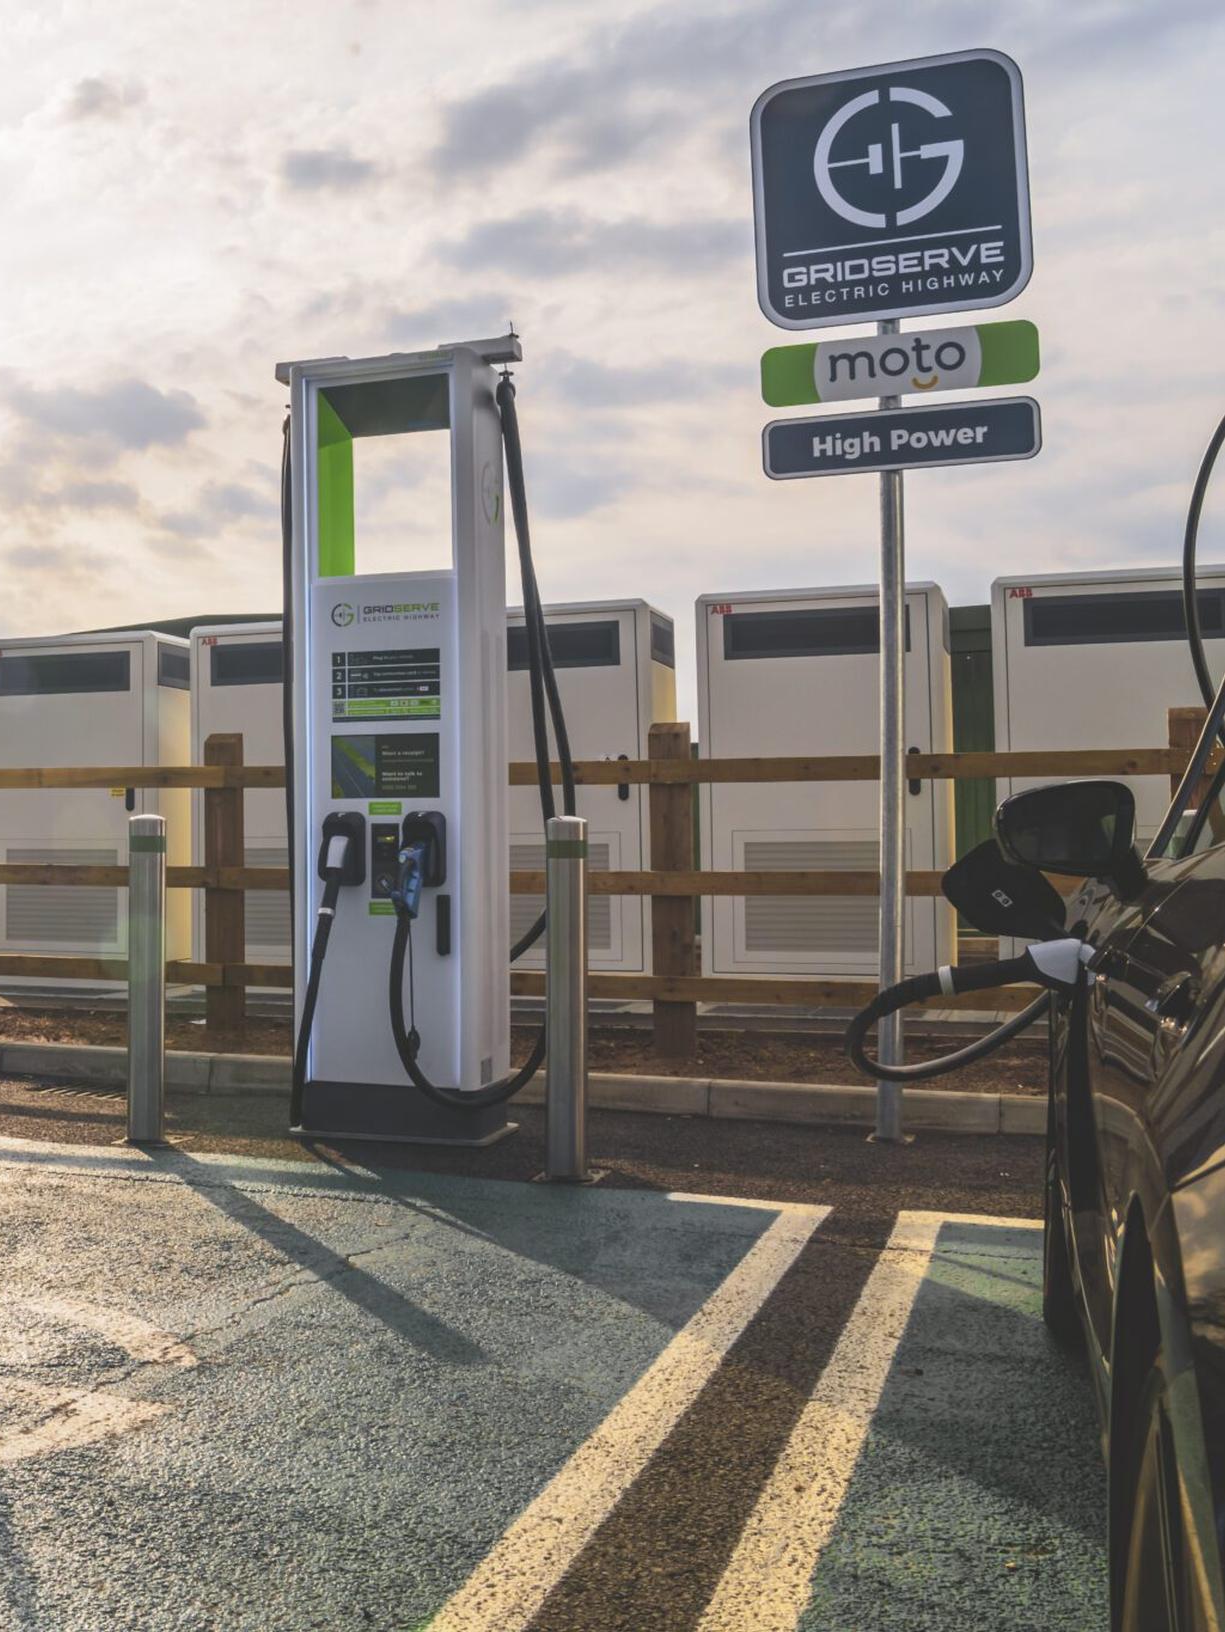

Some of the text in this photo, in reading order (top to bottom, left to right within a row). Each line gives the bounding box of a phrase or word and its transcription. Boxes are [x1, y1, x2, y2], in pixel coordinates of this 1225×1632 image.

[782, 241, 1005, 289] GRIDSERVE
[784, 268, 1004, 308] ELECTRIC HIGHWAY
[828, 336, 966, 383] moto
[812, 425, 988, 460] High Power
[1009, 587, 1033, 599] ABB
[363, 602, 441, 615] GRIDSERVE
[710, 603, 733, 615] ABB
[336, 671, 342, 680] 2
